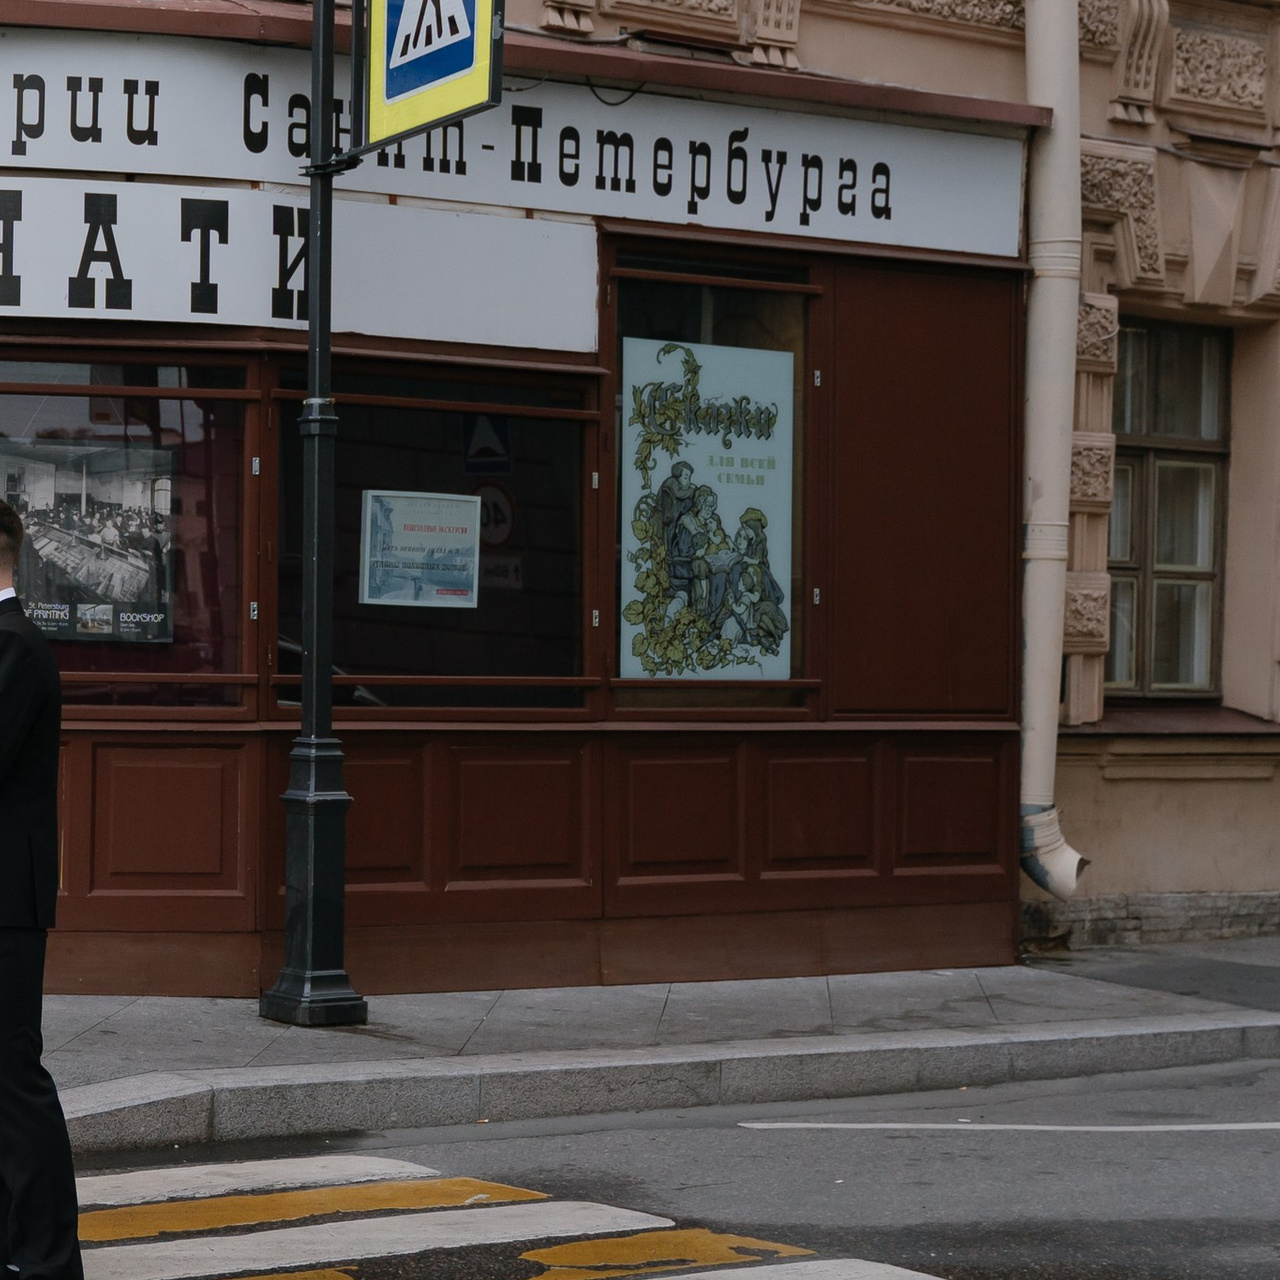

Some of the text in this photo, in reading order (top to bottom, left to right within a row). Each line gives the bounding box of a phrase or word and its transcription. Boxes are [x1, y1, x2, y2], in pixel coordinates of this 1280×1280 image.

[37, 602, 69, 610] Petersburg
[33, 609, 69, 620] PRINTING
[119, 612, 165, 623] BOOKSHOP
